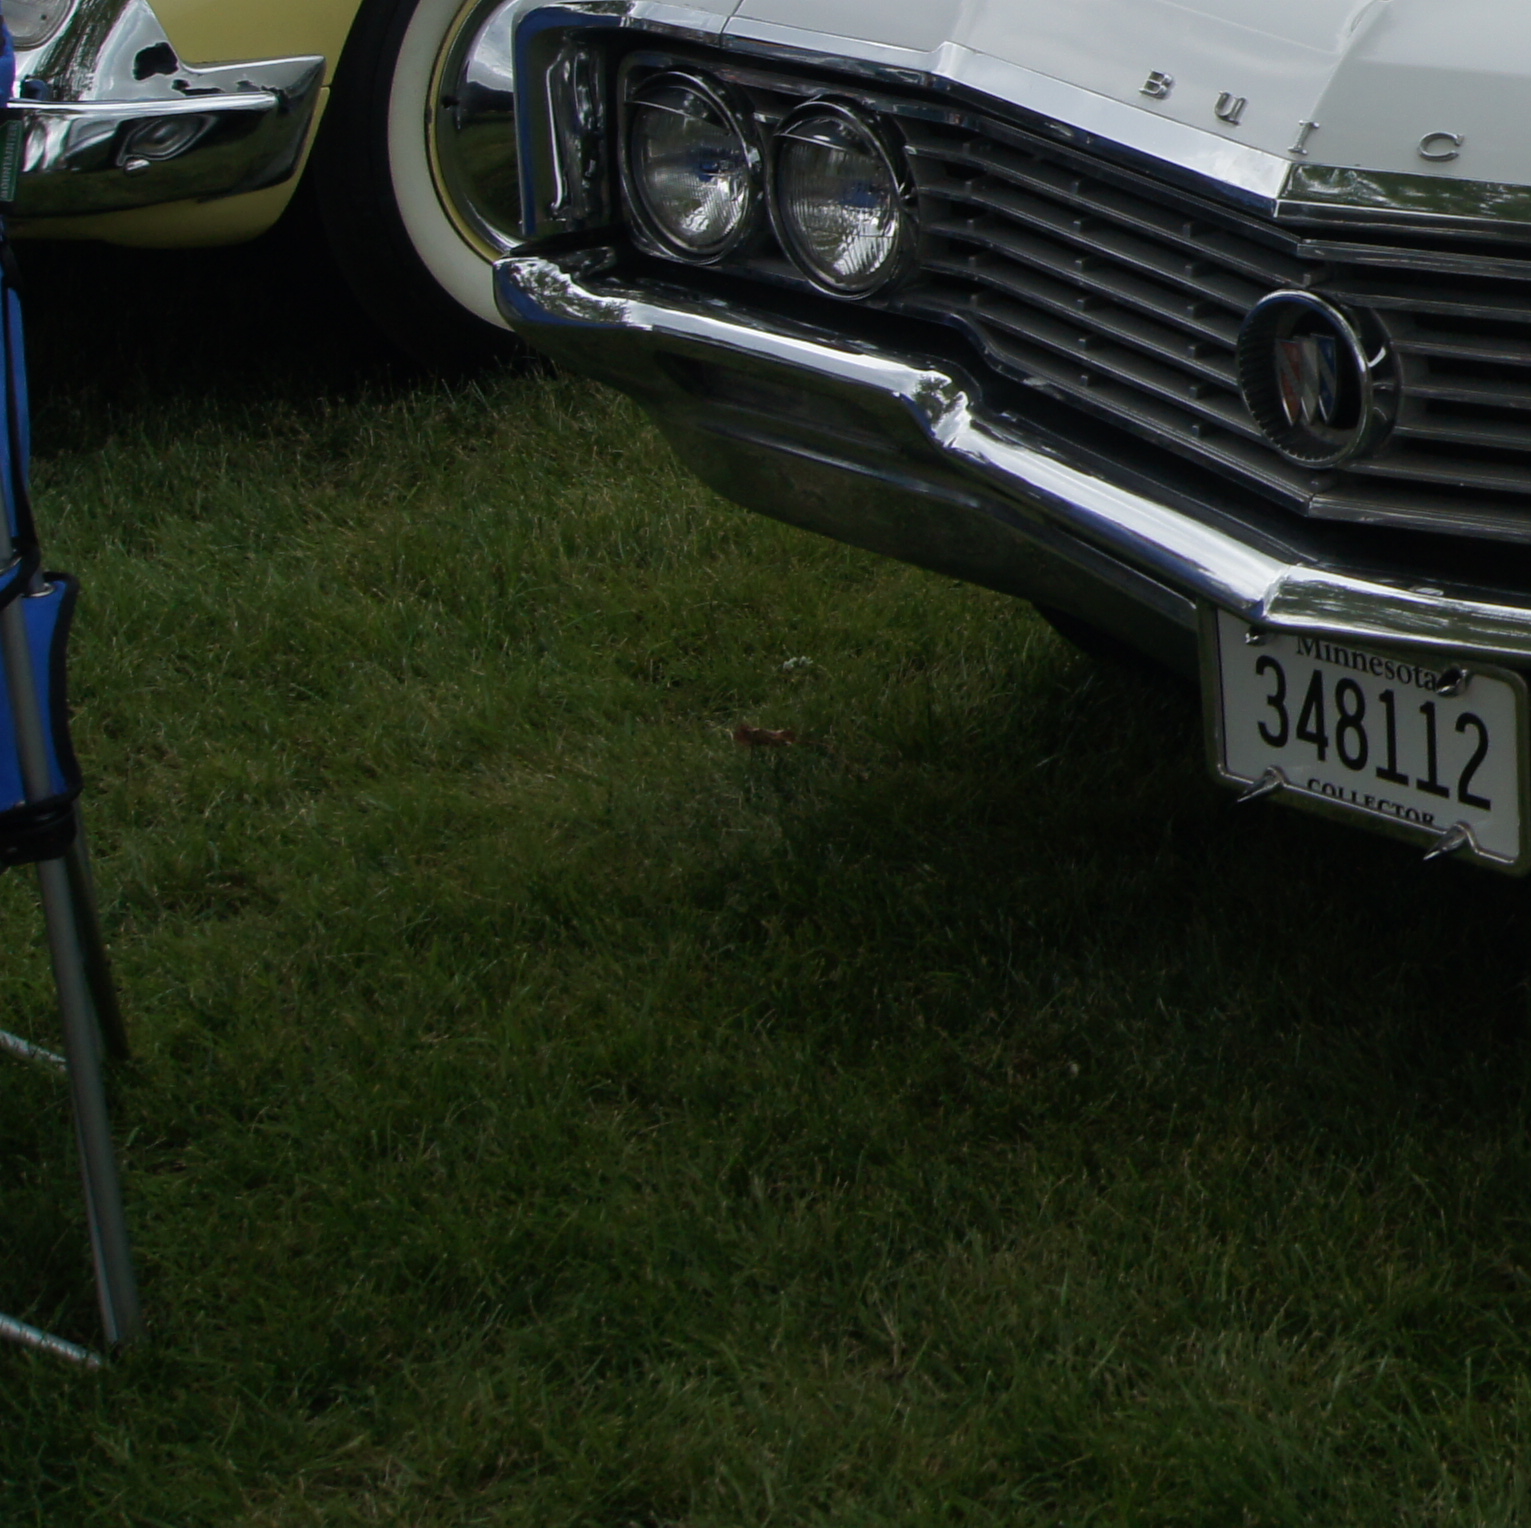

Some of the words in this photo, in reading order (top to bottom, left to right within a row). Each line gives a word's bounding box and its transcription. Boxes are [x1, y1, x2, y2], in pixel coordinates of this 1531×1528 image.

[1295, 637, 1439, 694] Minnesota
[1255, 654, 1492, 812] 348112
[1306, 778, 1437, 826] COLLECTOR
